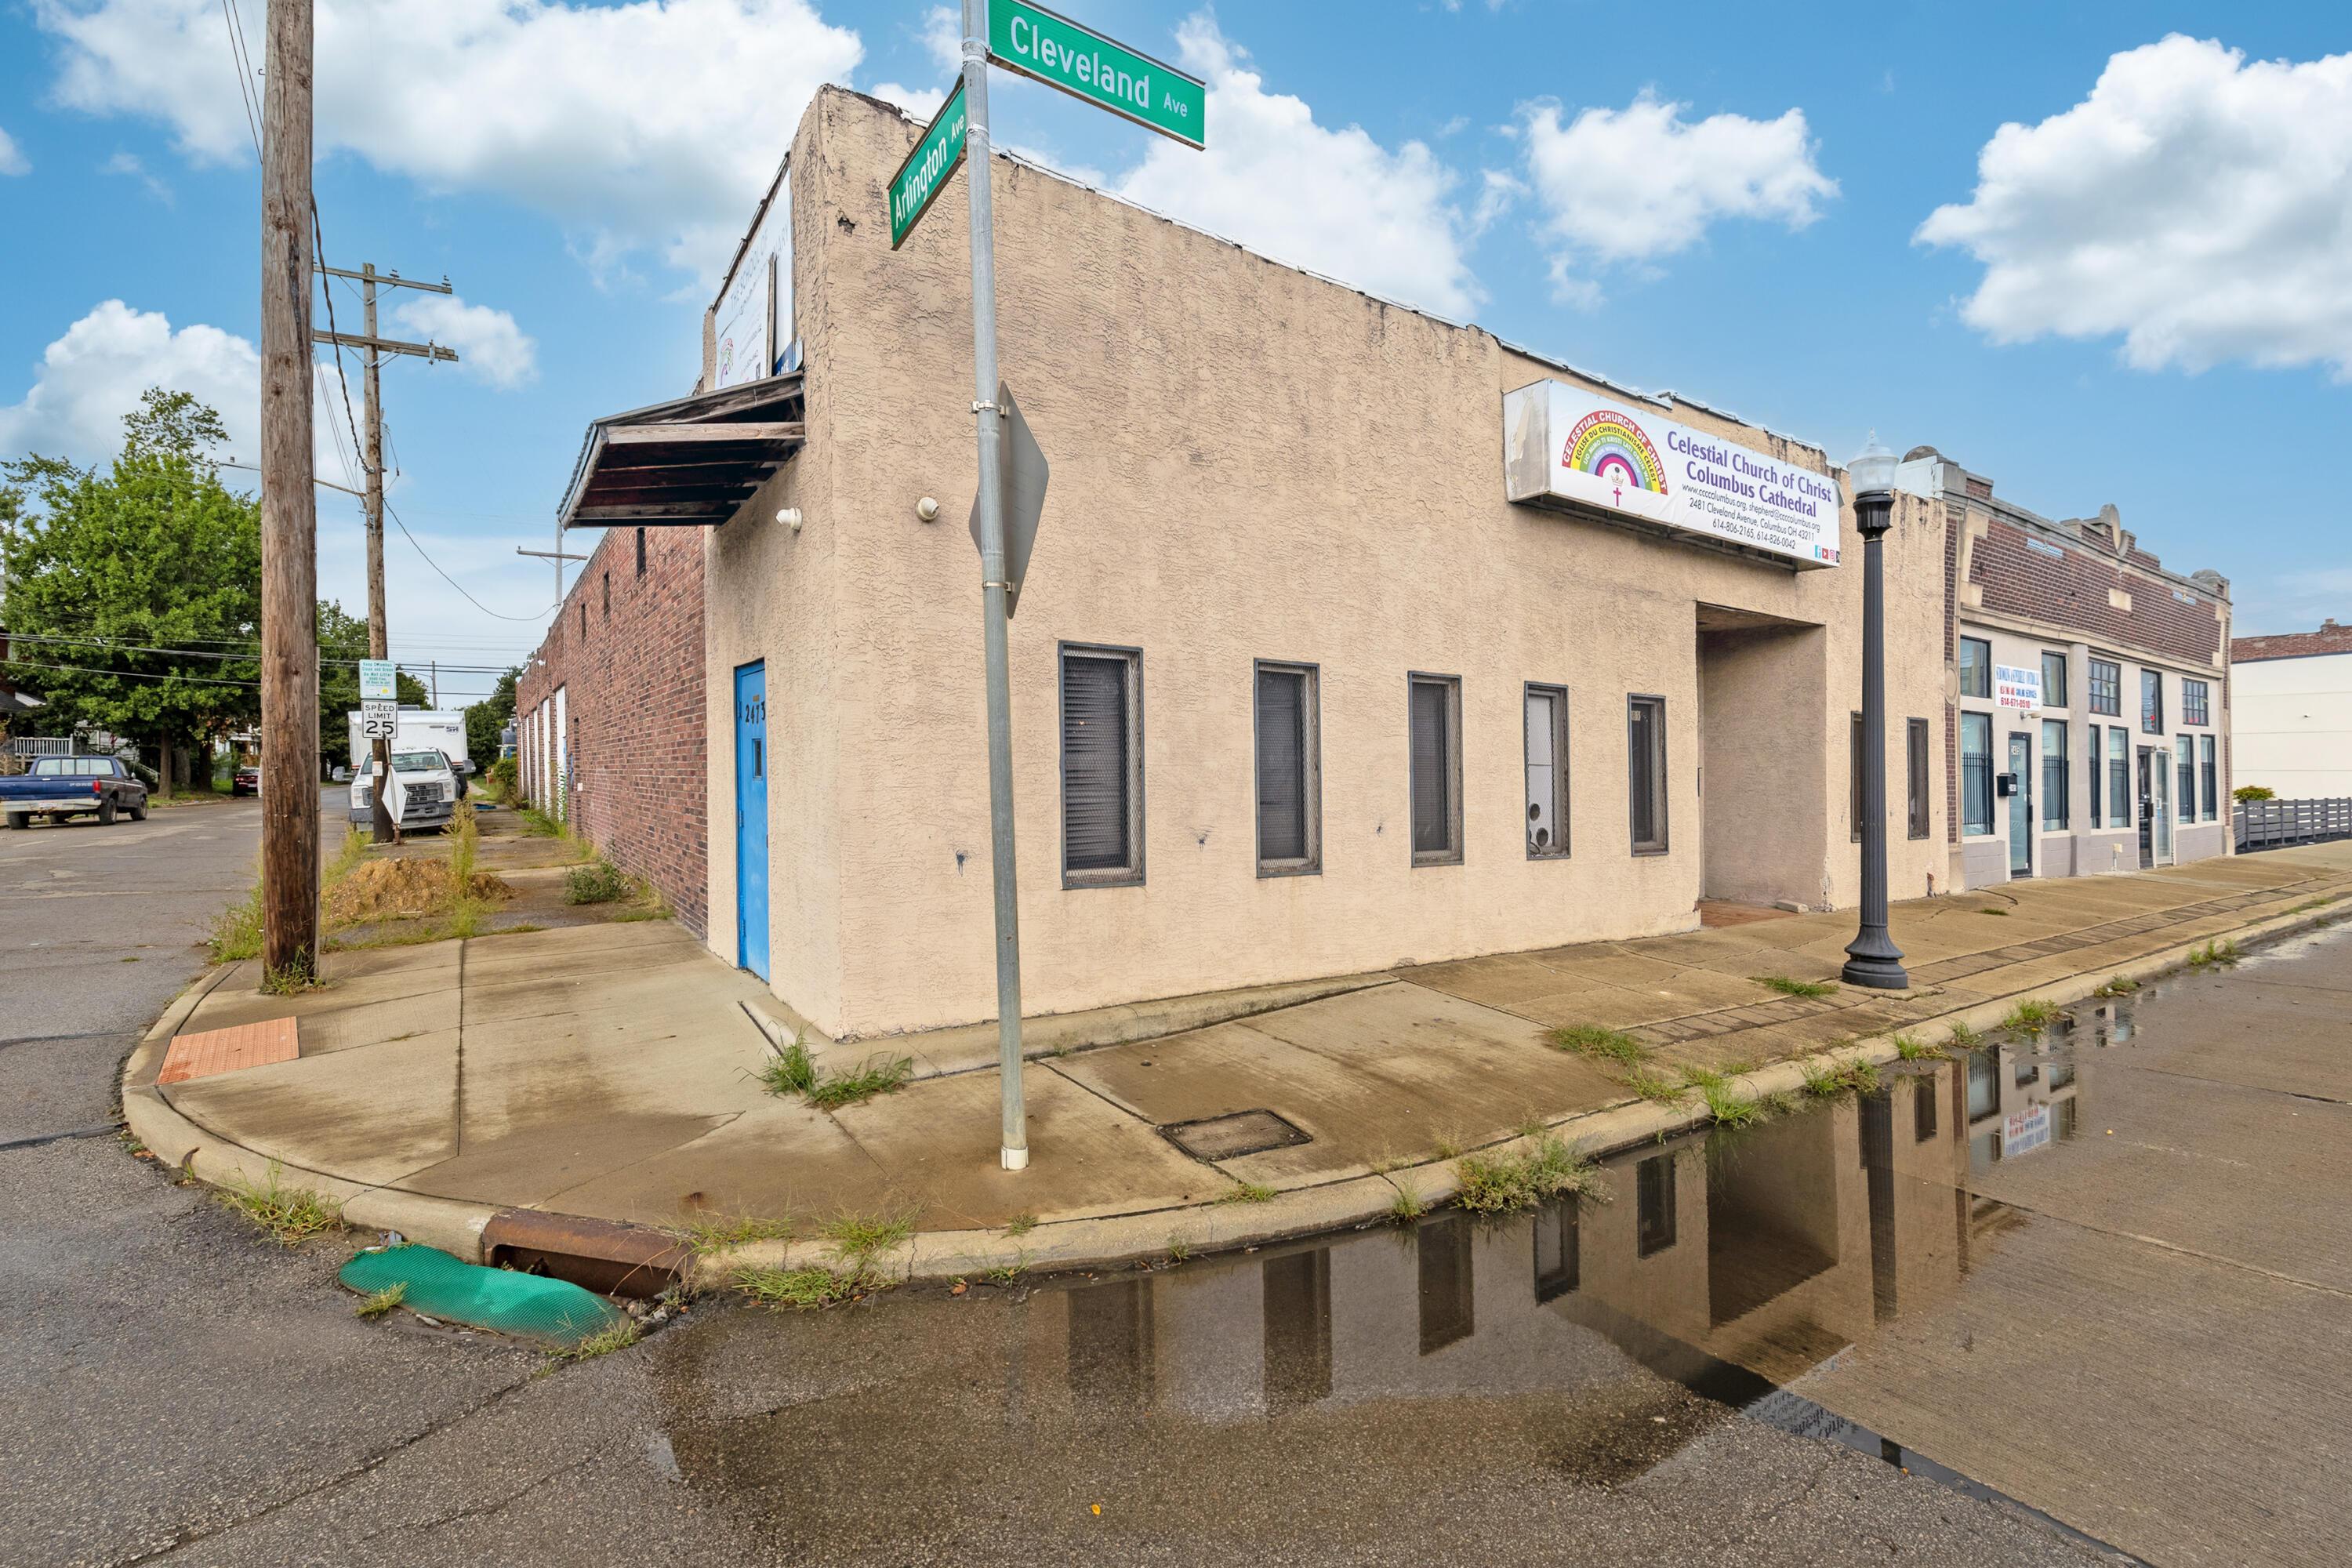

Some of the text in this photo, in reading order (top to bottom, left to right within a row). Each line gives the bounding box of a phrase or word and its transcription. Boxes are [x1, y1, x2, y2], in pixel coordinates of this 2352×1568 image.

[1011, 16, 1187, 118] Cleveland Ave
[895, 114, 964, 229] Arlington Ave
[1563, 412, 1667, 489] CELESTIAL CHURCH OF CHRIST
[1576, 426, 1657, 481] EGLISE DU CHRISTIANISME CELEST
[1668, 430, 1831, 502] Celestial Church of Christ
[1686, 461, 1817, 517] Columbus Cathedral
[1690, 497, 1814, 541] 2481 Cleveland Avenue, Columbus OH 43211
[1712, 518, 1755, 539] 614-806-2165,
[366, 720, 394, 735] 25
